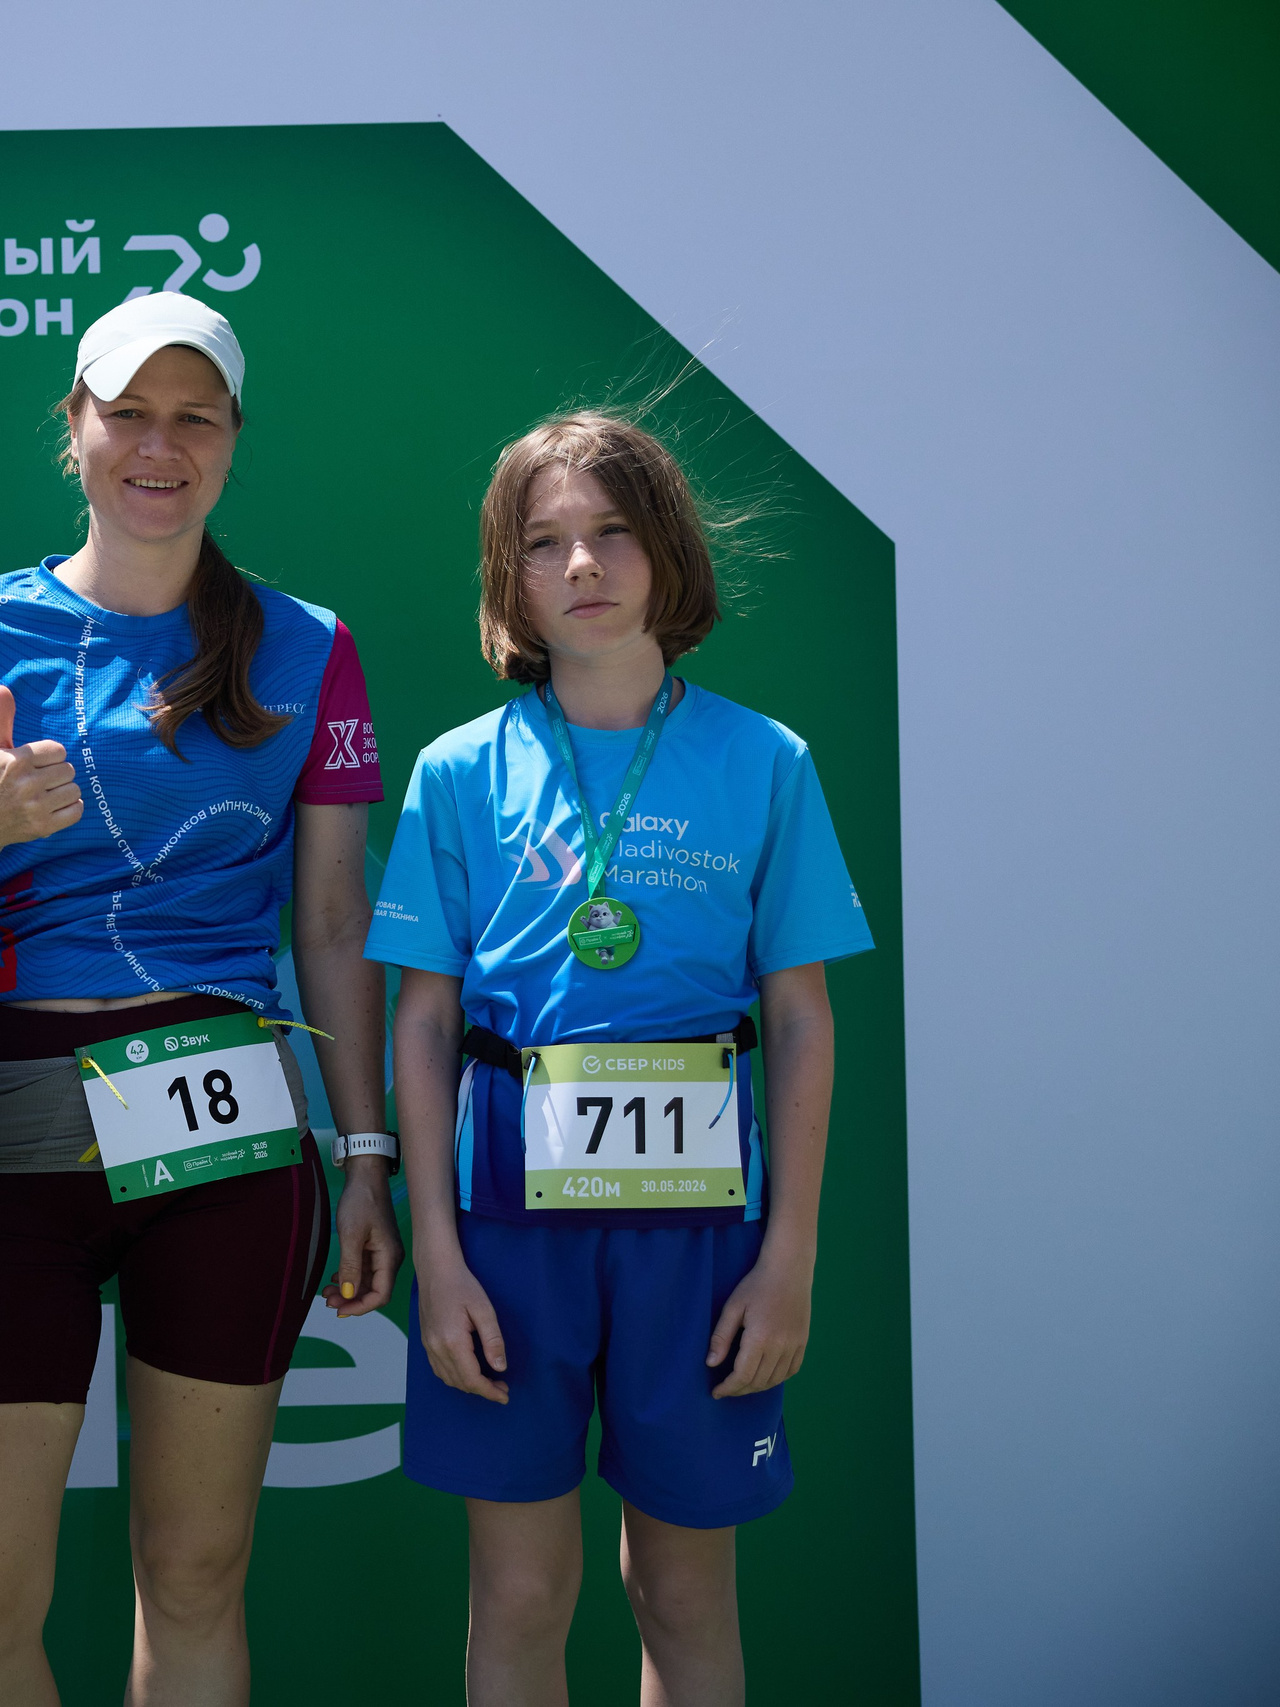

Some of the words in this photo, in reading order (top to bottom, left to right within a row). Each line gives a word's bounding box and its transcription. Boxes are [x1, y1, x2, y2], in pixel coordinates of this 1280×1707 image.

[657, 691, 669, 714] 2026
[82, 747, 96, 774] БЕГ,
[90, 775, 123, 839] КОТОРЫЙ
[209, 799, 273, 826] ДИСТАНЦИЯ
[616, 792, 632, 817] 2026
[618, 840, 741, 874] ladivostok
[389, 911, 419, 923] ТЕХНИКА
[180, 1034, 210, 1047] Звук
[130, 1044, 145, 1056] 4,2
[605, 1058, 648, 1071] СБЕР
[652, 1058, 685, 1071] KIDS
[167, 1069, 239, 1132] 18
[576, 1096, 684, 1154] 711
[252, 1141, 268, 1151] 30.05
[254, 1150, 268, 1160] 2026
[641, 1179, 707, 1193] 30.05.2026
